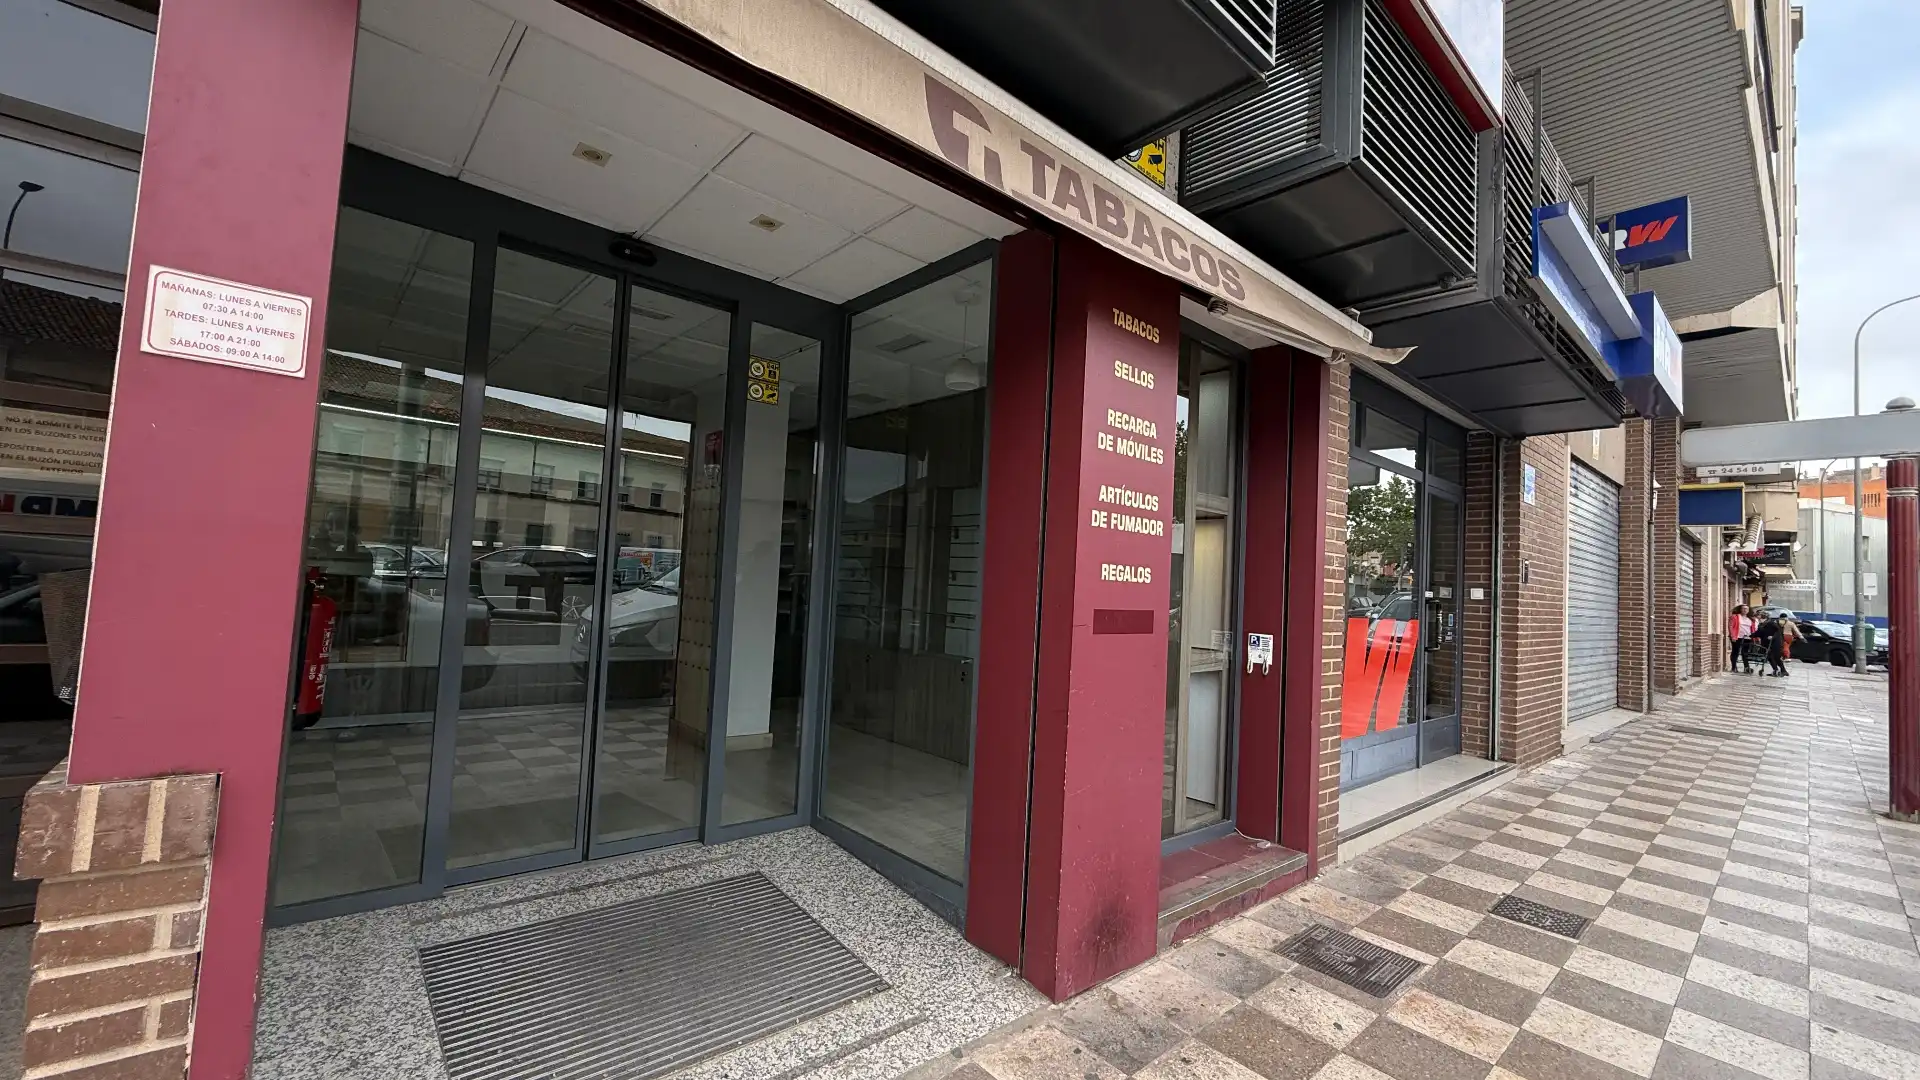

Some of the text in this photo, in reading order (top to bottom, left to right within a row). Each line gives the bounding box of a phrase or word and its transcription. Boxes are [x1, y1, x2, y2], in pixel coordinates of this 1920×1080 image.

[1020, 138, 1246, 301] TABACOS
[1601, 216, 1679, 251] RW
[161, 280, 303, 316] MAÑANAS: LUNES A VIERNES
[202, 302, 264, 321] 07:30 A 14:00
[164, 308, 295, 340] TARDES: LUNES A VIERNES
[1112, 307, 1160, 344] TABACOS
[169, 337, 223, 353] SÁBADOS:
[252, 351, 260, 359] A
[262, 352, 285, 364] 14:00
[200, 330, 261, 348] 17:00 A 21:00
[1114, 359, 1155, 390] SELLOS
[14, 427, 32, 435] LOS
[34, 430, 77, 440] BUZONES
[79, 435, 106, 443] INTER
[35, 419, 71, 430] ADMITE
[74, 424, 107, 434] PUBLIC
[1107, 408, 1157, 439] RECARGA
[56, 448, 105, 459] EXCLUSIVA
[1097, 431, 1164, 465] DE MÓVILES
[63, 459, 104, 469] PUBLICIT
[1098, 484, 1159, 512] ARTÍCULOS
[1091, 509, 1164, 537] DE FUMADOR
[1100, 563, 1152, 584] REGALOS
